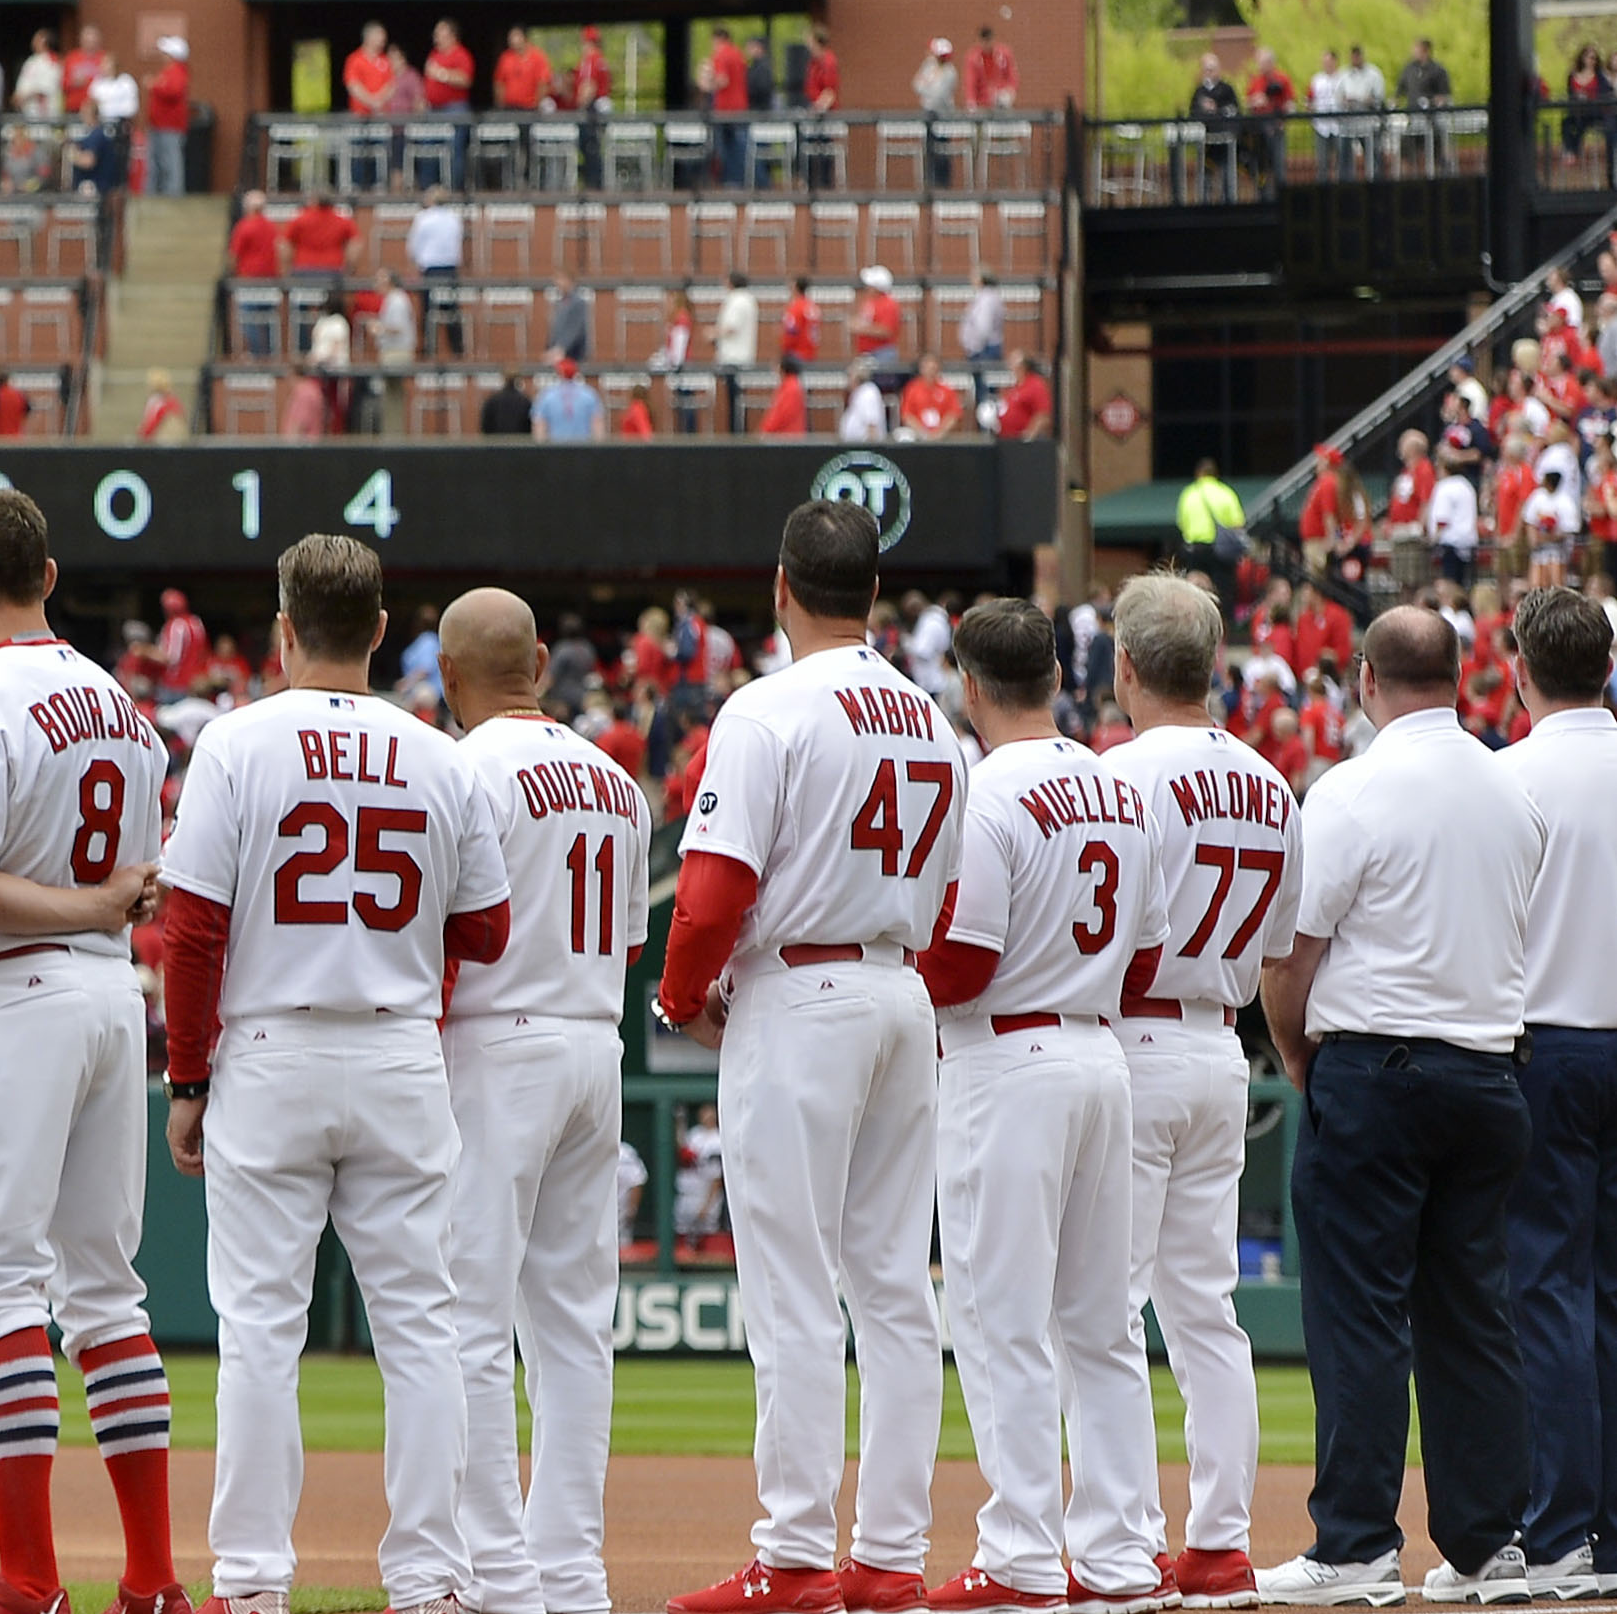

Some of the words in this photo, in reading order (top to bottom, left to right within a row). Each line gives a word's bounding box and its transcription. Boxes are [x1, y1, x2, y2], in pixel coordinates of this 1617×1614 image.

[298, 729, 408, 789] BELL
[834, 686, 934, 742] MABRY
[71, 759, 126, 884] 8
[517, 760, 638, 828] OQUENDO
[700, 795, 716, 810] OT
[851, 758, 952, 878] 47
[1018, 777, 1146, 840] MUELLER
[1168, 769, 1290, 836] MALONEY
[274, 801, 427, 933] 25
[567, 833, 613, 956] 11
[1072, 841, 1119, 956] 3
[1177, 844, 1285, 959] 77
